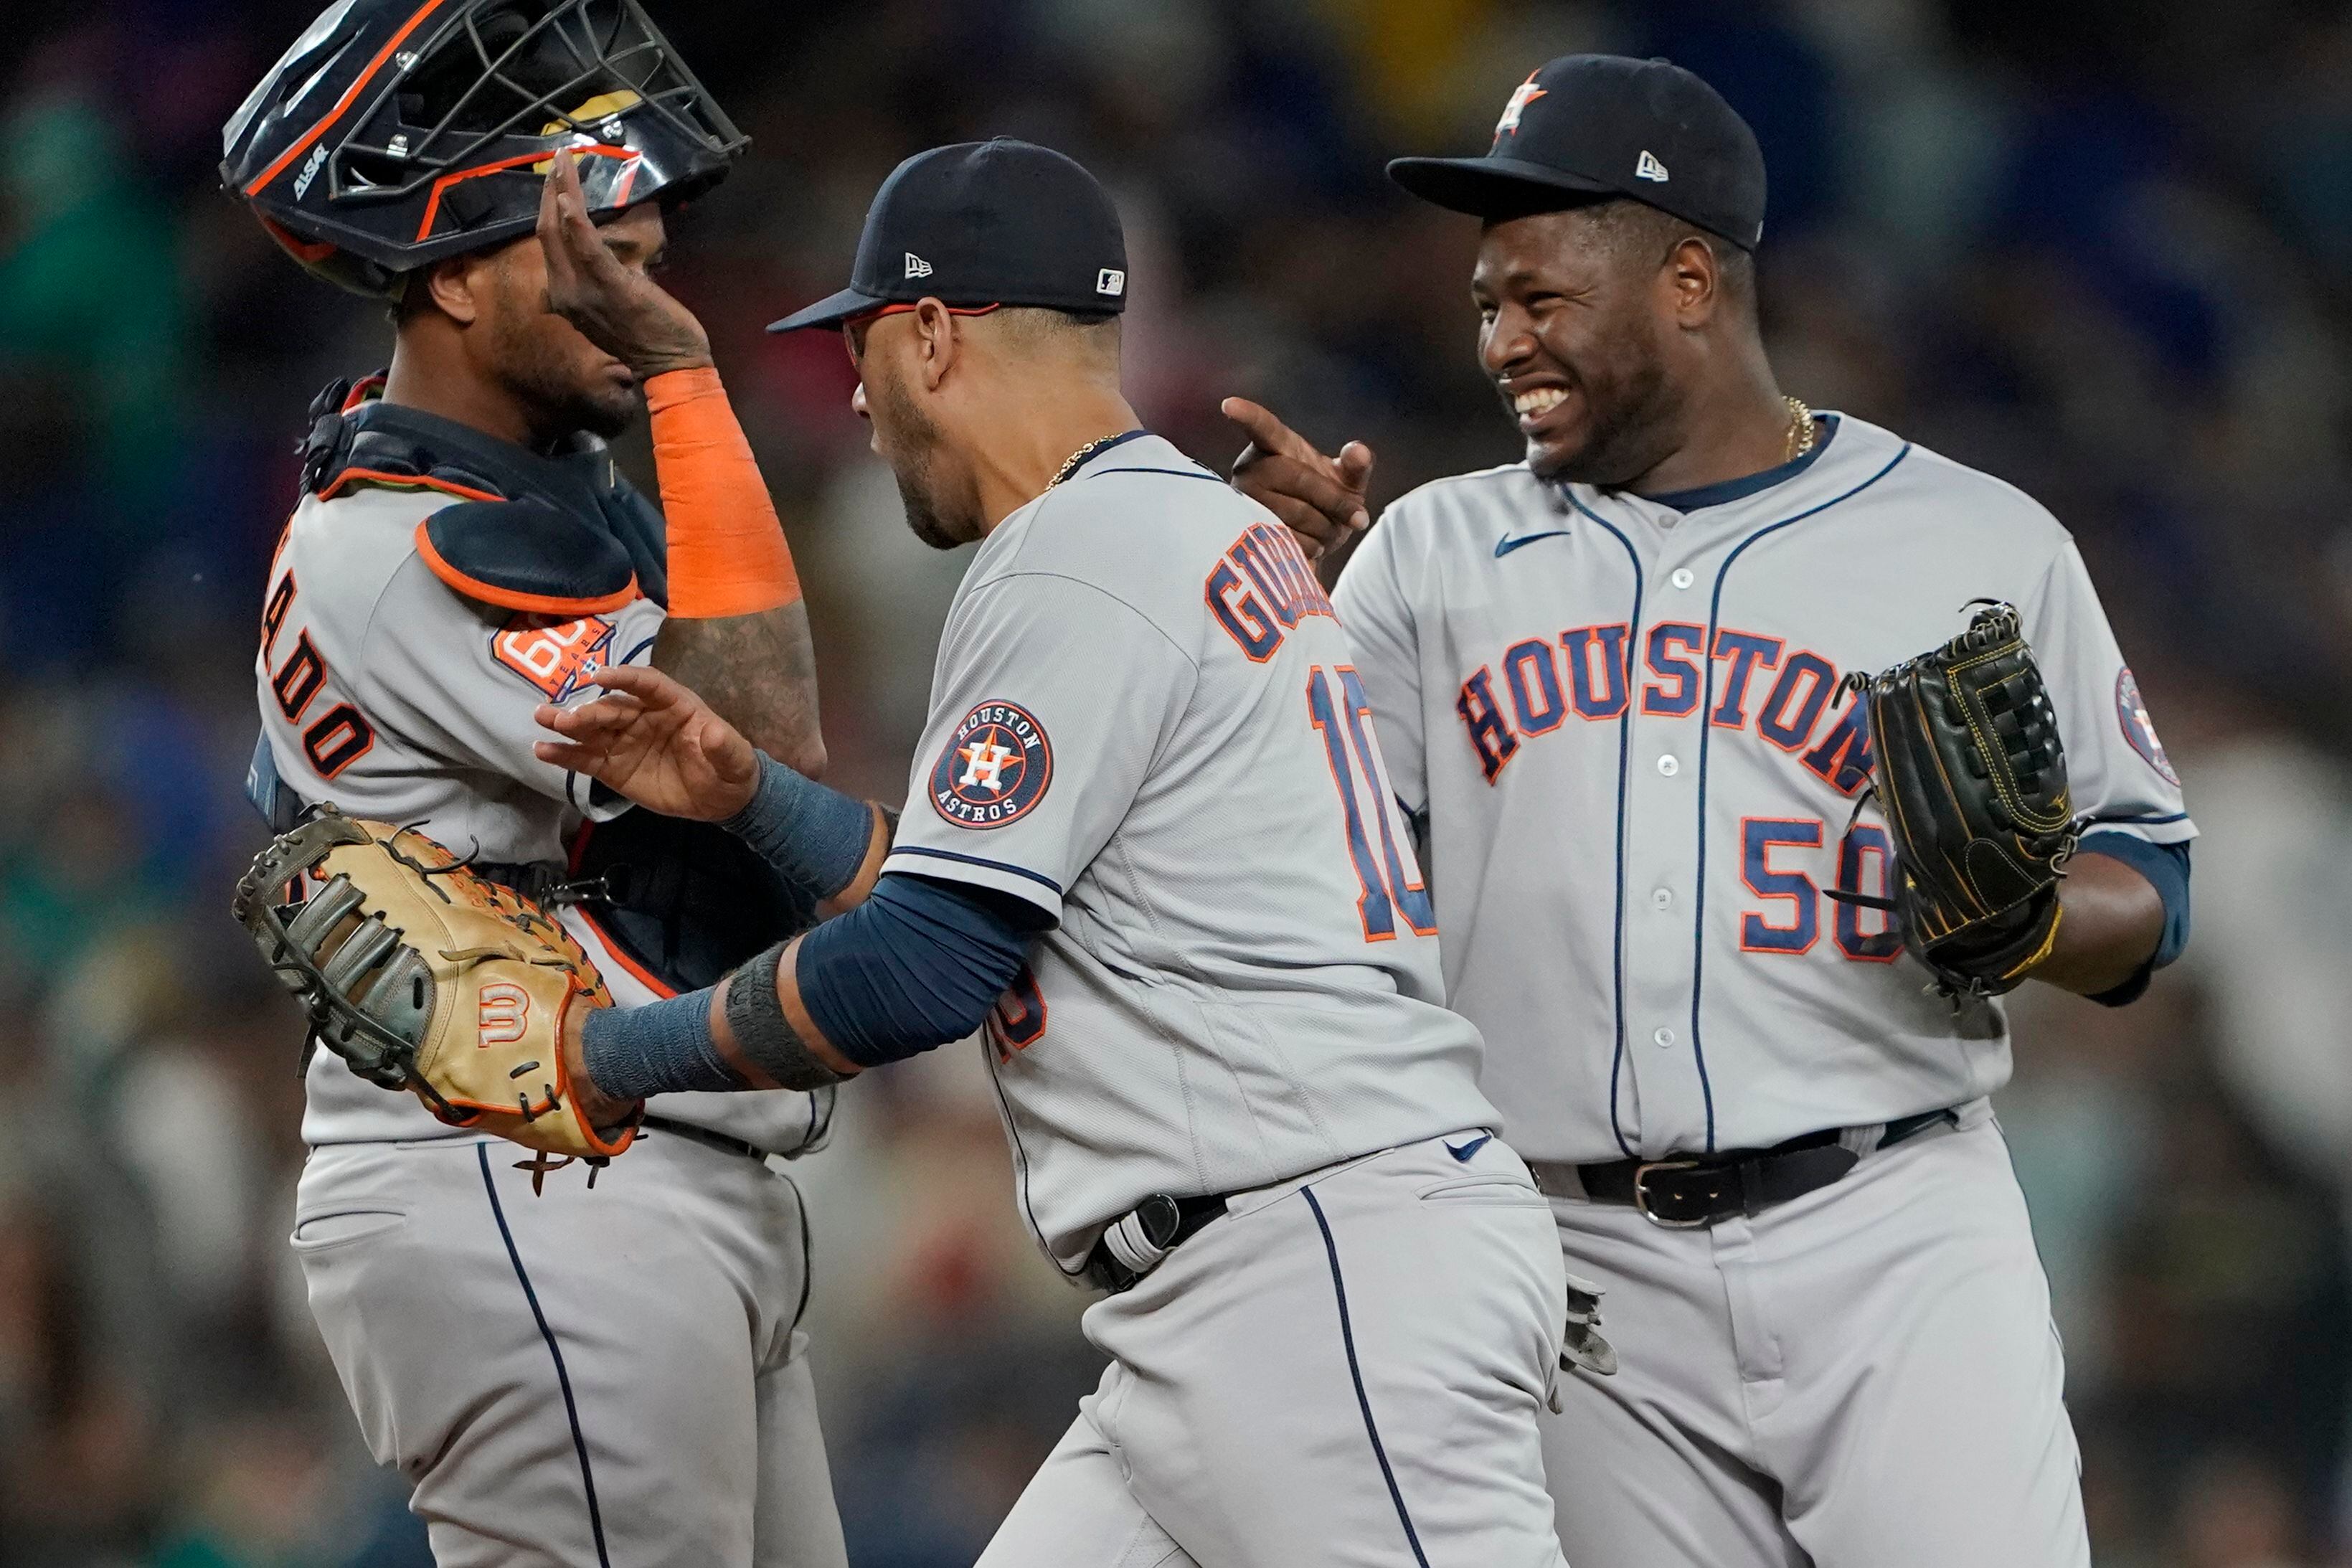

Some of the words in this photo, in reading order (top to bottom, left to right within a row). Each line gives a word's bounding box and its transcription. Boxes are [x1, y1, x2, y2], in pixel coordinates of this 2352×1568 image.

[260, 512, 375, 780] ADO
[548, 627, 602, 686] YEARS
[958, 707, 1042, 749] HOUSTON
[1457, 620, 1878, 797] HOUSTON
[958, 741, 1011, 790] H
[937, 789, 1017, 823] ASTROS
[1739, 816, 1905, 964] 50
